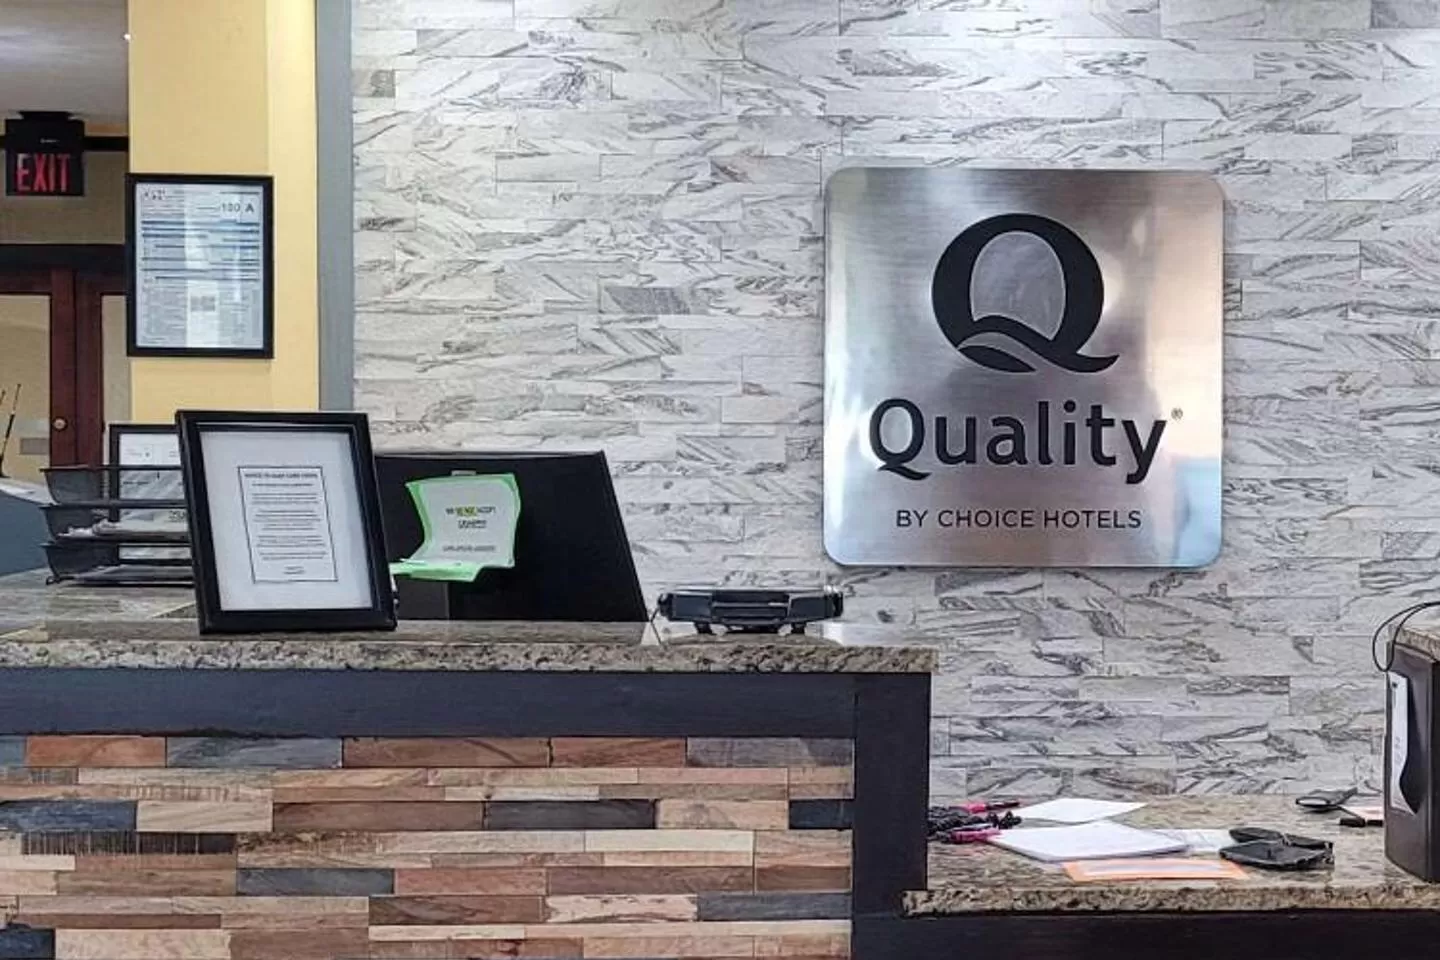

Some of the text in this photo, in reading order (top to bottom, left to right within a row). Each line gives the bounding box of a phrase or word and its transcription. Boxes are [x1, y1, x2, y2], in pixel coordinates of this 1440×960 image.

[16, 152, 71, 193] EXIT
[931, 212, 1120, 374] Q
[869, 397, 1168, 485] Quality
[895, 509, 1142, 530] BY CHOICE HOTELS
